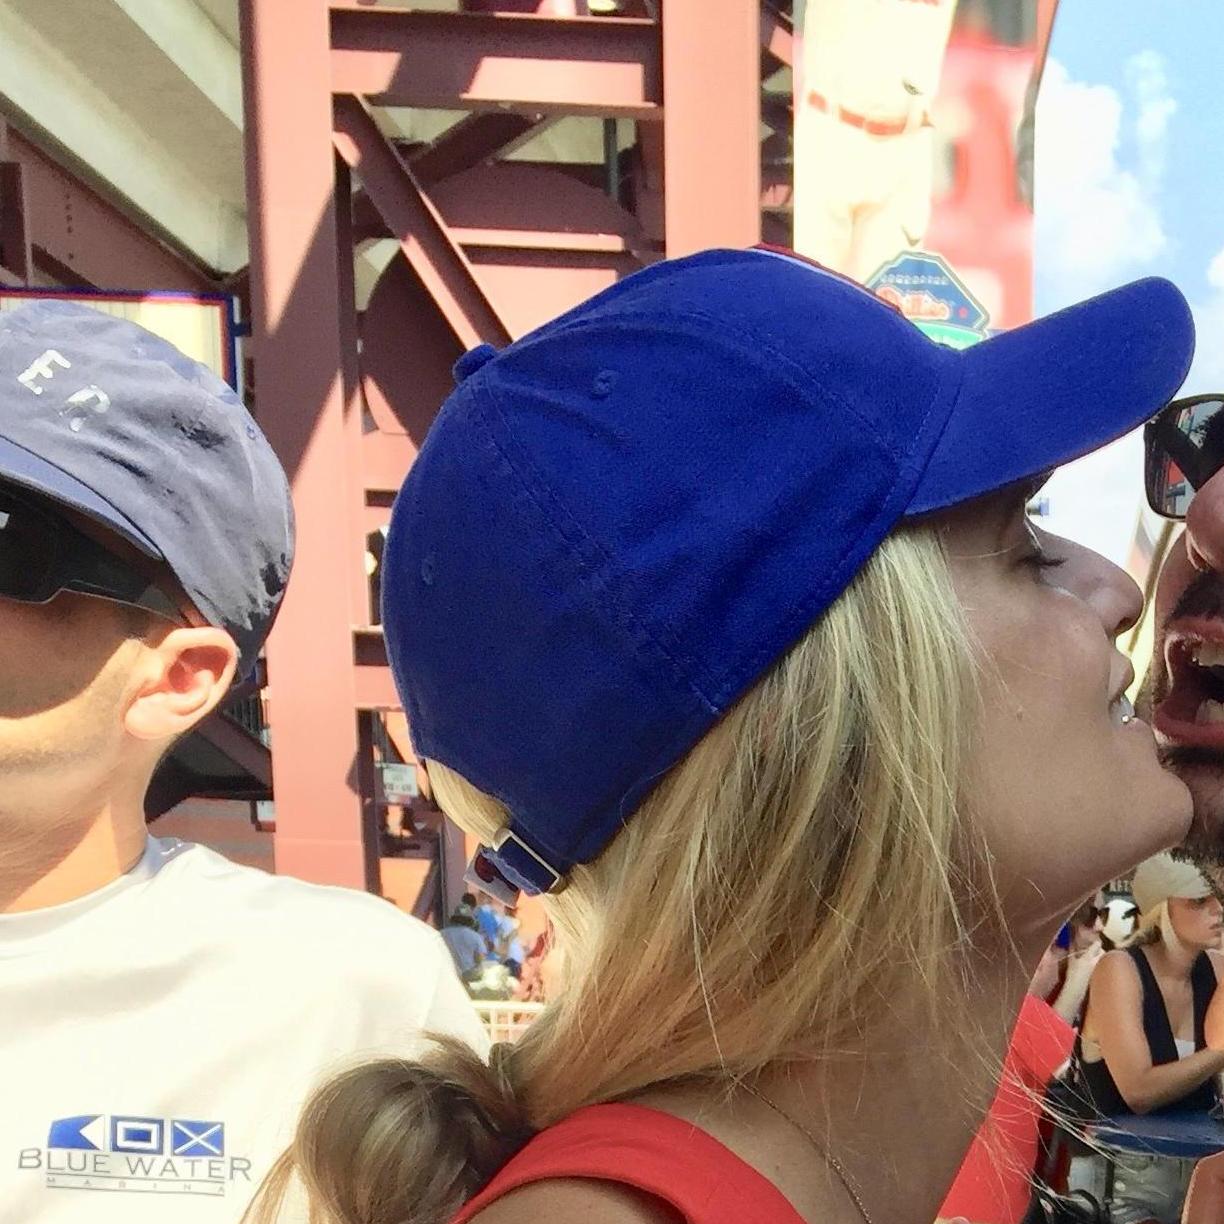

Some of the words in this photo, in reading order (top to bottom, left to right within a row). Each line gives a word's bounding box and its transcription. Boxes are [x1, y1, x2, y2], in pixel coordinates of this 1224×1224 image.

[17, 1147, 112, 1174] BLUE
[125, 1155, 252, 1182] WATER
[46, 1176, 225, 1194] MARINA
